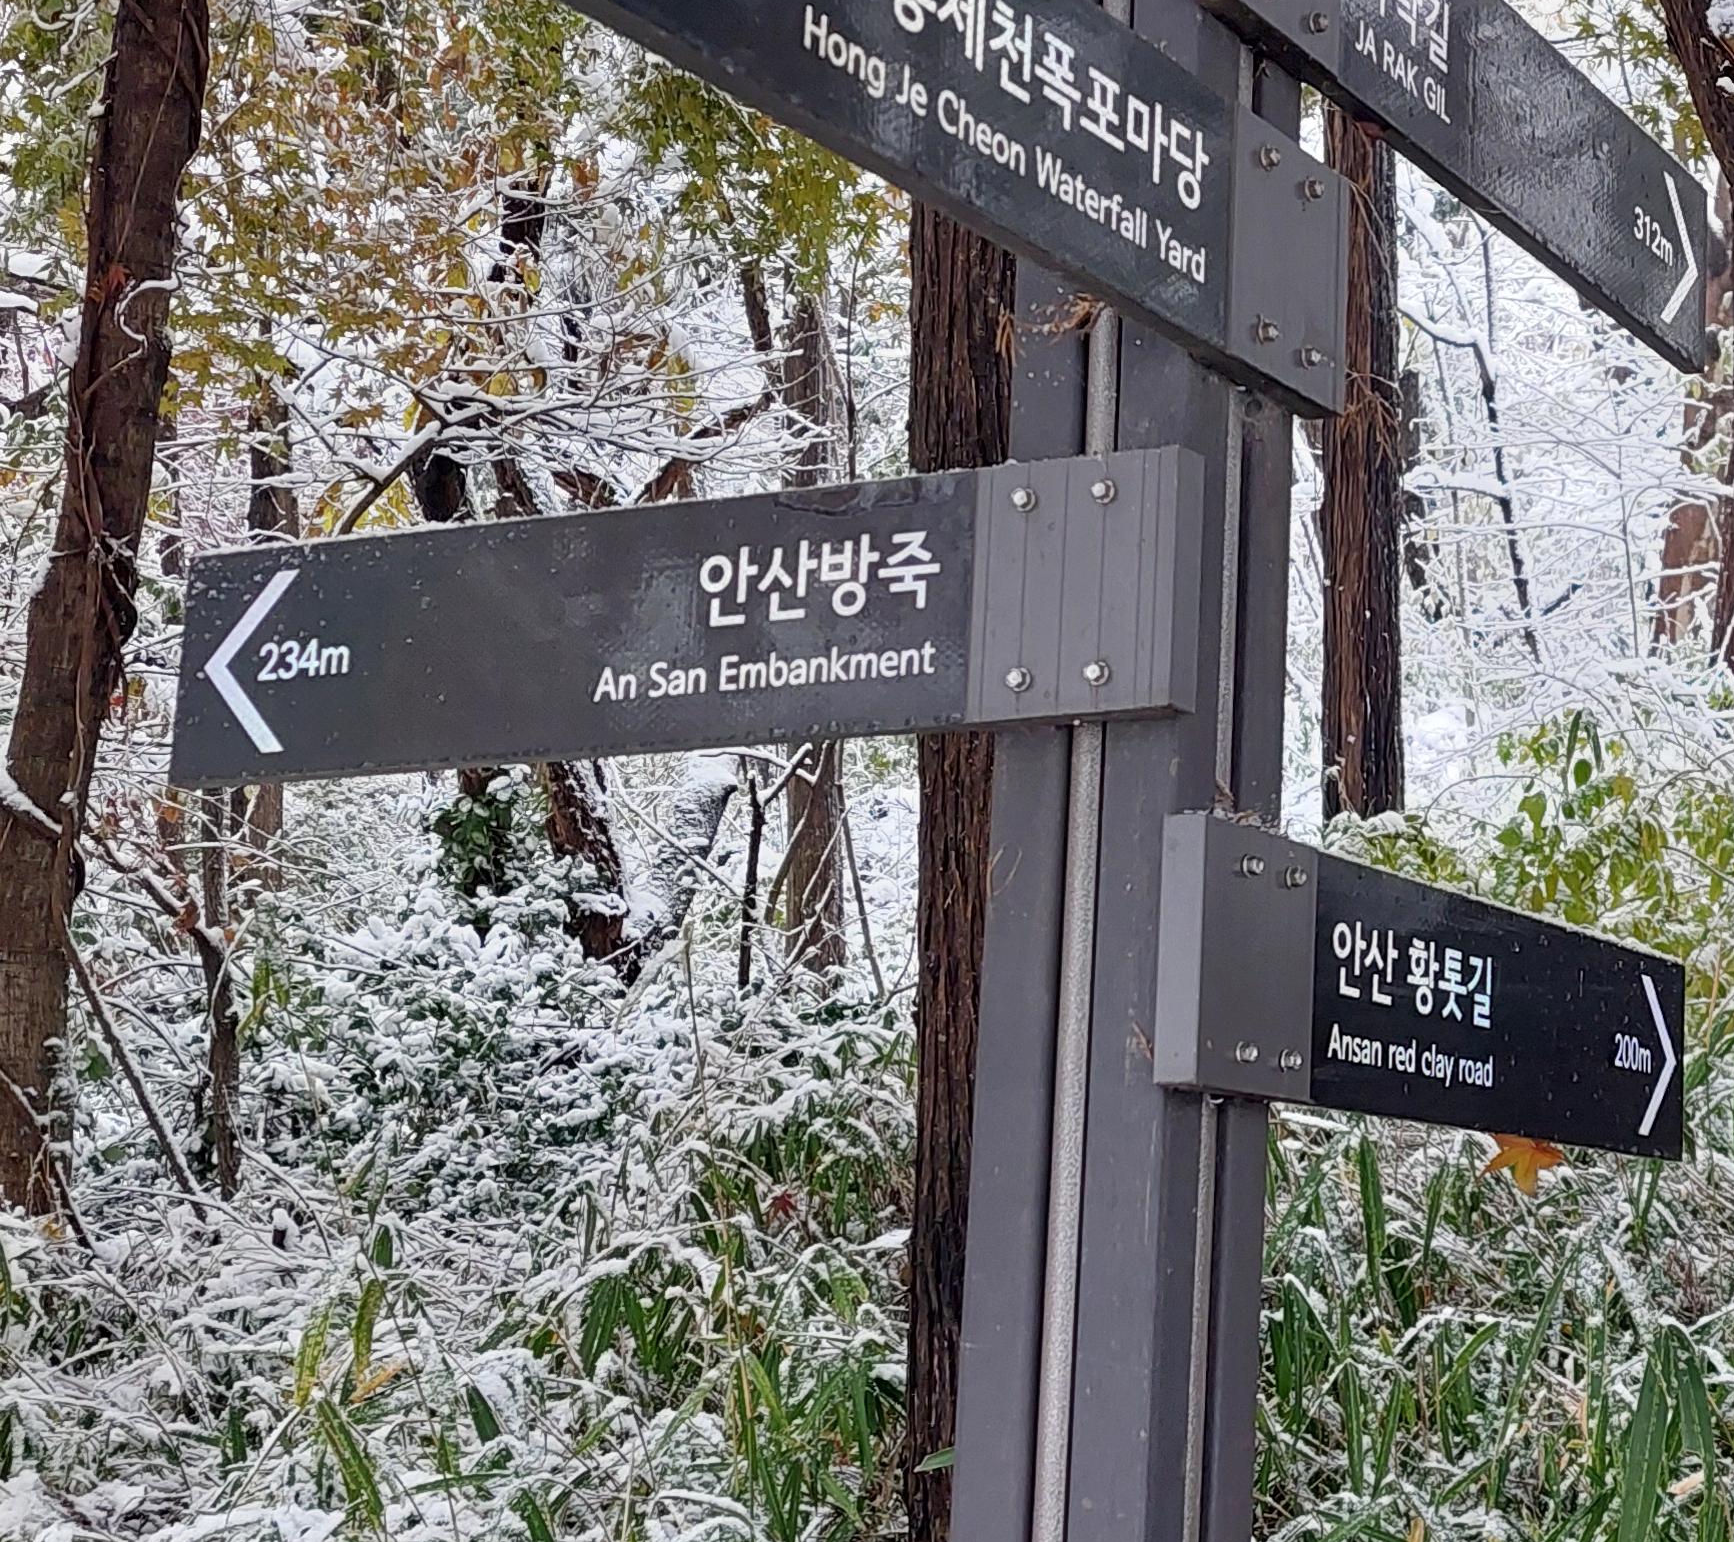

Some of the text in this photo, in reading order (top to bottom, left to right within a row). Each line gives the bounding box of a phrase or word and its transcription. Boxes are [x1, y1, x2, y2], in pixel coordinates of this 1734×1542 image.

[1355, 20, 1451, 125] JA RAK GIL
[802, 4, 1206, 284] Hong Je Cheon Waterfall Yard
[1634, 206, 1673, 267] 312m
[700, 530, 941, 627] 안산방죽
[257, 638, 350, 681] 234m
[592, 640, 937, 703] An San Embankment
[1332, 921, 1493, 1029] 안산 황톳길
[1327, 1023, 1493, 1087] Ansan red clay road
[1614, 1033, 1651, 1074] 200m
